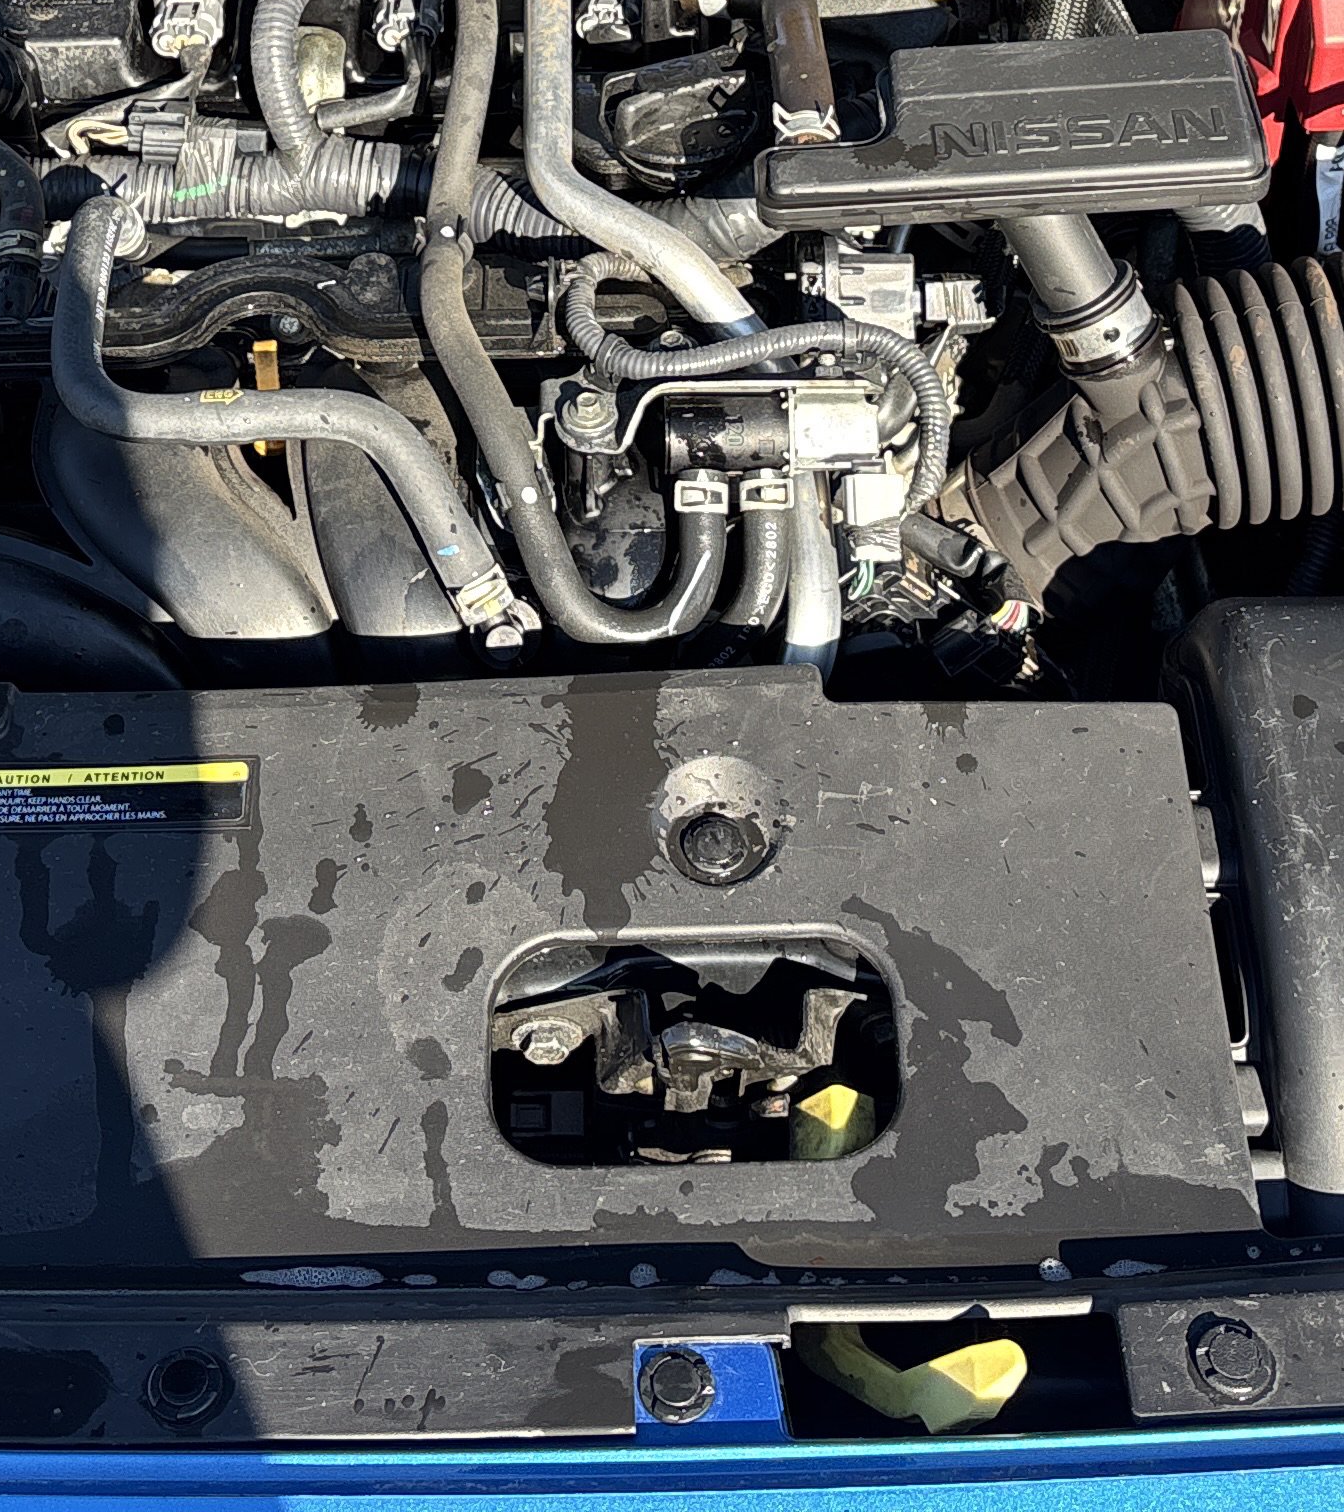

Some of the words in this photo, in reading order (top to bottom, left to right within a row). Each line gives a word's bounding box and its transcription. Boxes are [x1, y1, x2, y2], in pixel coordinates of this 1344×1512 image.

[930, 105, 1229, 162] NISSAN
[67, 773, 73, 783] /
[84, 770, 166, 783] ATTENTION
[27, 796, 46, 805] KEEP
[47, 795, 75, 805] HANDS
[66, 803, 90, 813] TOUT
[24, 814, 37, 823] NE
[38, 813, 54, 823] PAS
[55, 813, 68, 822] EN
[68, 812, 120, 822] APPROCHER
[121, 811, 137, 820] LES
